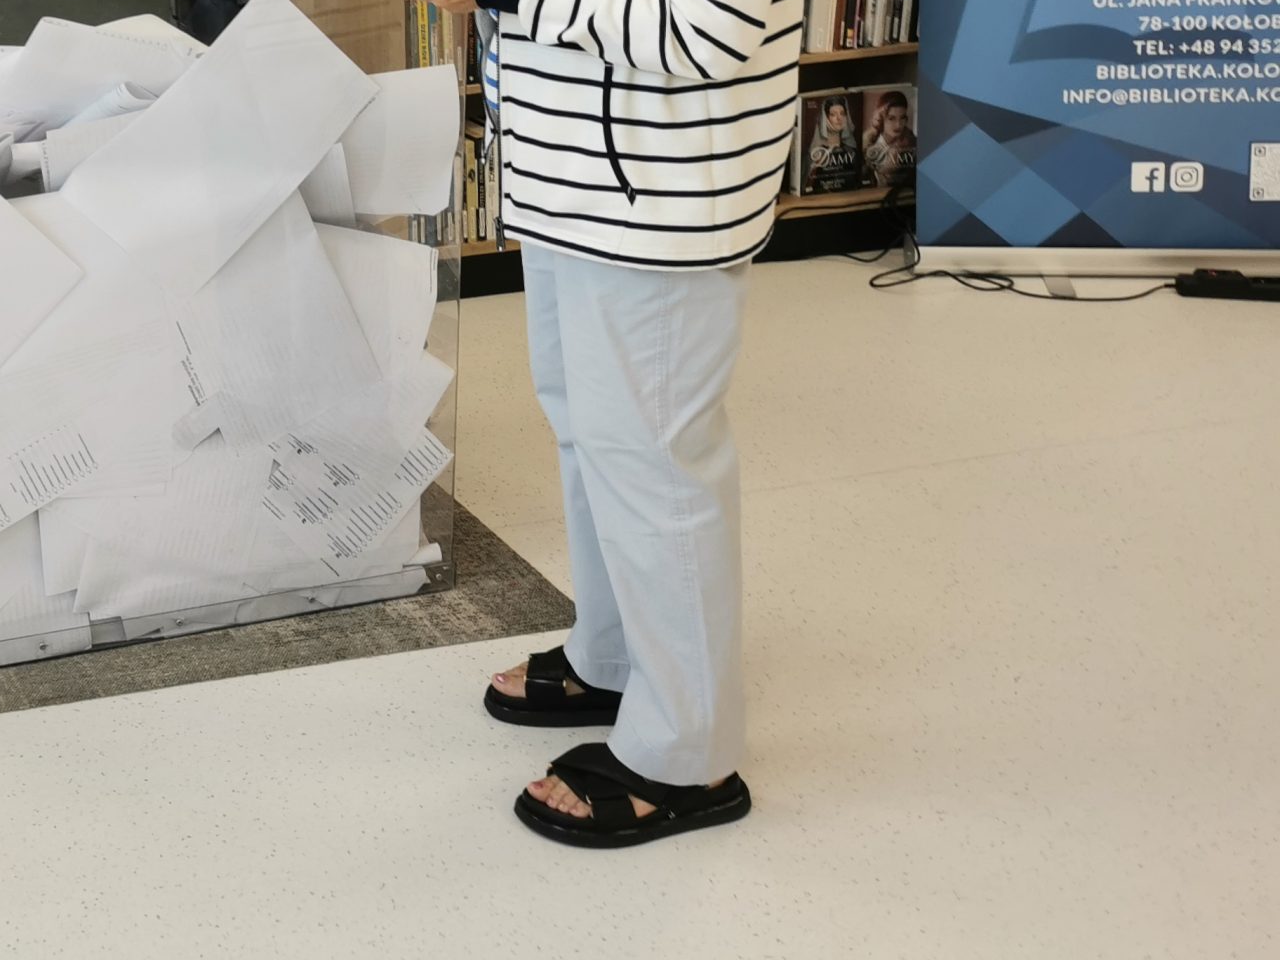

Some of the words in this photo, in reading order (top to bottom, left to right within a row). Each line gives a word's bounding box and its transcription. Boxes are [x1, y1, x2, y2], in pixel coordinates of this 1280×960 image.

[1138, 15, 1208, 31] 78-100
[1133, 40, 1175, 56] TEL:
[1178, 39, 1215, 55] +48
[1219, 39, 1244, 55] 94
[1248, 39, 1280, 54] 352
[1096, 63, 1280, 80] BIBLIOTEKA.KOLO
